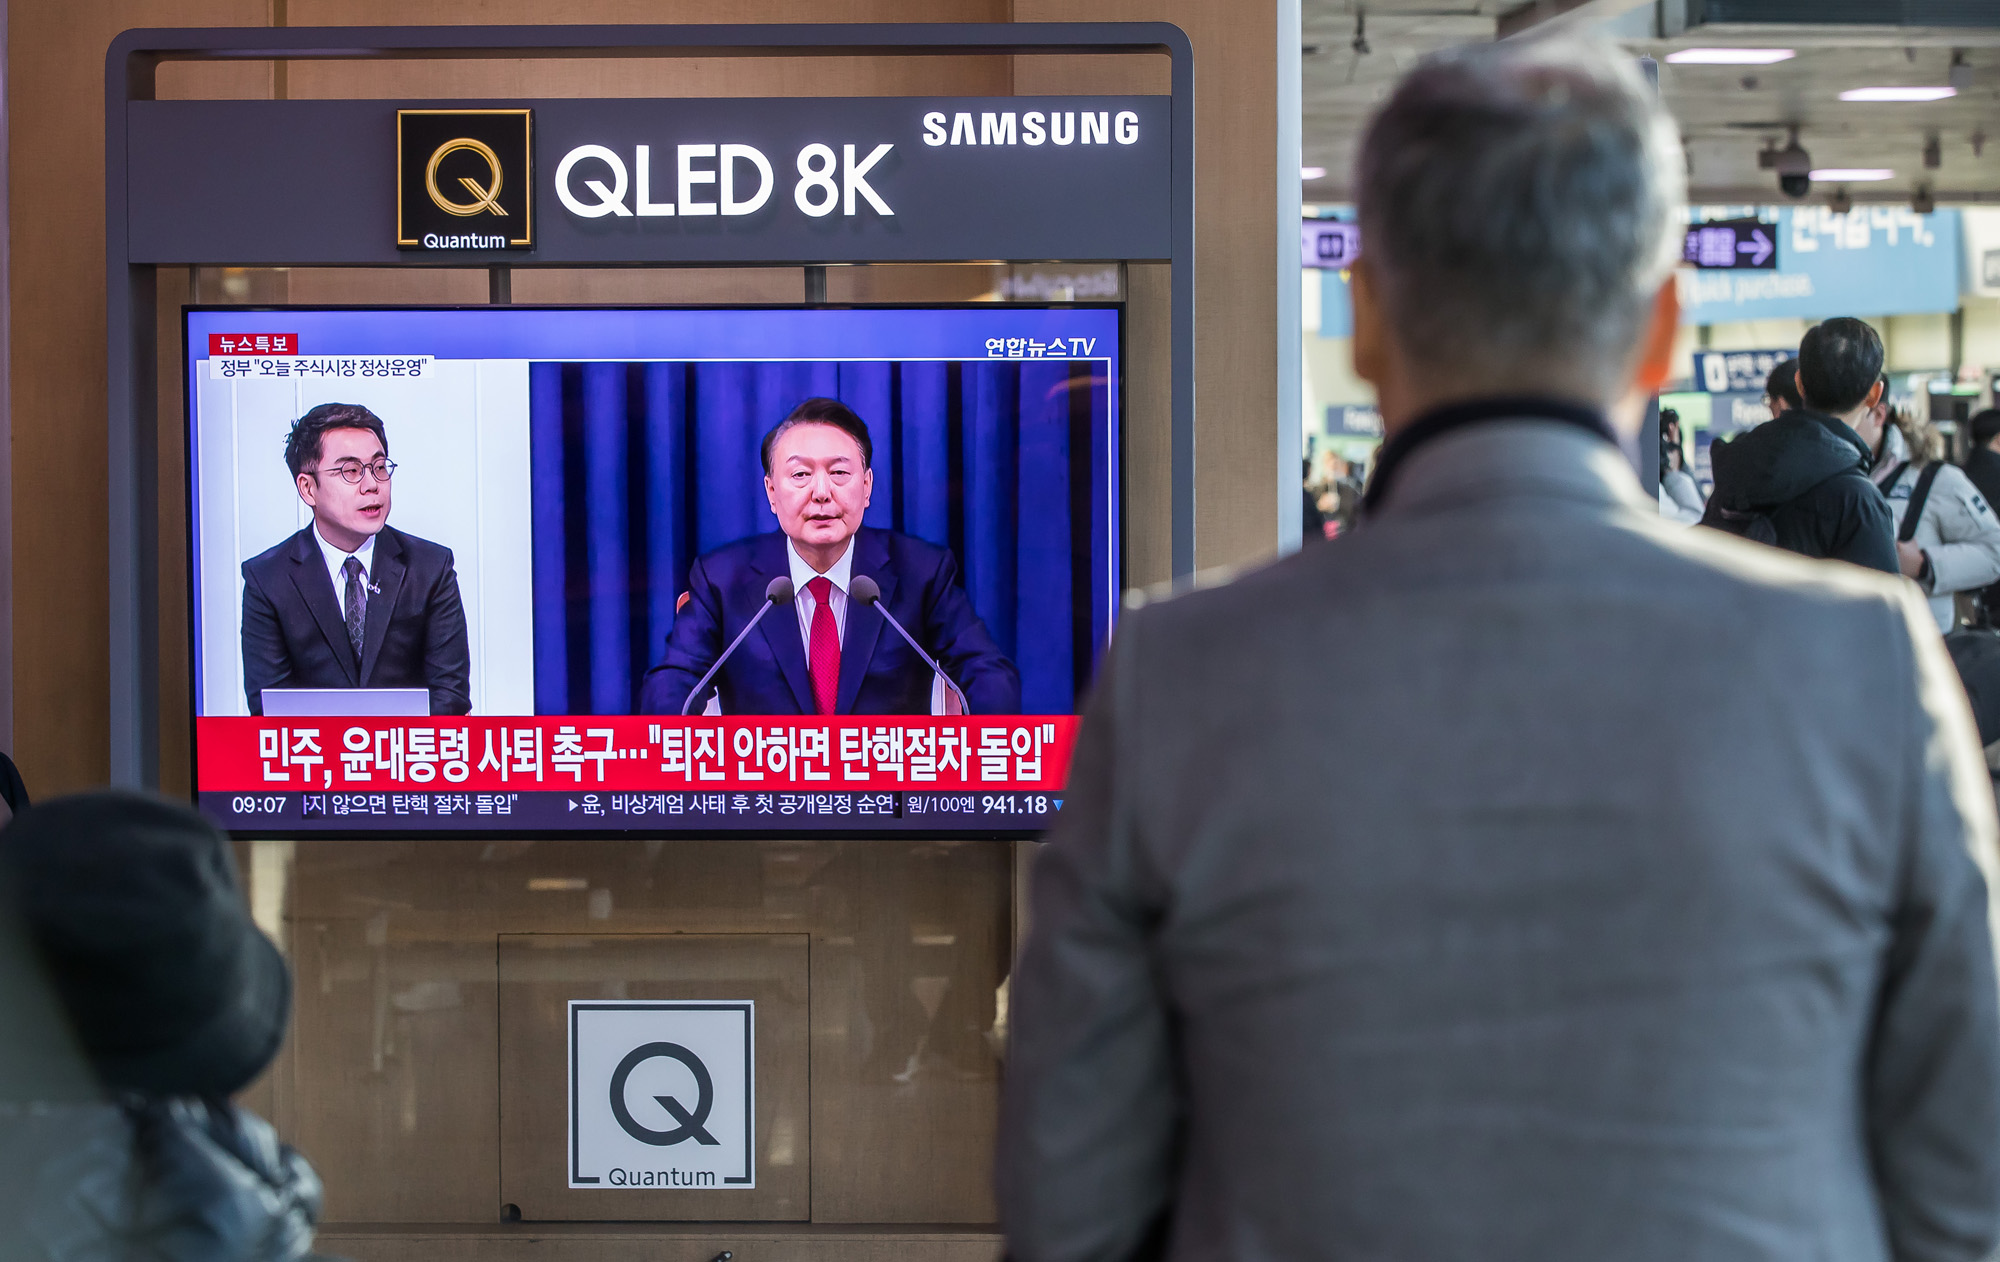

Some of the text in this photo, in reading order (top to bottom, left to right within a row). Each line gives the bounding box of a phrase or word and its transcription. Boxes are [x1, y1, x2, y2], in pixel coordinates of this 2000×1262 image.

[922, 110, 1139, 147] SAMSUNG
[425, 137, 509, 217] Q
[554, 143, 895, 218] QLED 8K
[423, 232, 506, 249] Quantum
[219, 336, 288, 353] 뉴스특보
[985, 337, 1097, 357] 연합뉴스TV
[220, 358, 427, 377] 정부 "오늘 주식시장 정상운영"
[259, 727, 333, 790] 민주,
[339, 726, 470, 783] 윤대통령
[477, 726, 544, 782] 사퇴
[733, 726, 831, 782] 안하면
[839, 726, 972, 782] 탄핵절차
[977, 723, 1055, 782] 돌입"
[232, 796, 287, 814] 09:07
[332, 794, 387, 816] 않으면
[392, 794, 429, 815] 탄핵
[433, 794, 472, 815] 절차
[474, 793, 518, 815] 돌입"
[581, 793, 606, 817] 윤,
[611, 794, 684, 815] 비상계엄
[688, 794, 726, 815] 사태
[730, 794, 751, 815] 후
[755, 794, 774, 815] 첫
[777, 793, 852, 815] 공개일정
[907, 795, 1048, 814] 원/100엔 941.18
[609, 1041, 722, 1147] Q
[608, 1167, 716, 1187] Quantum
